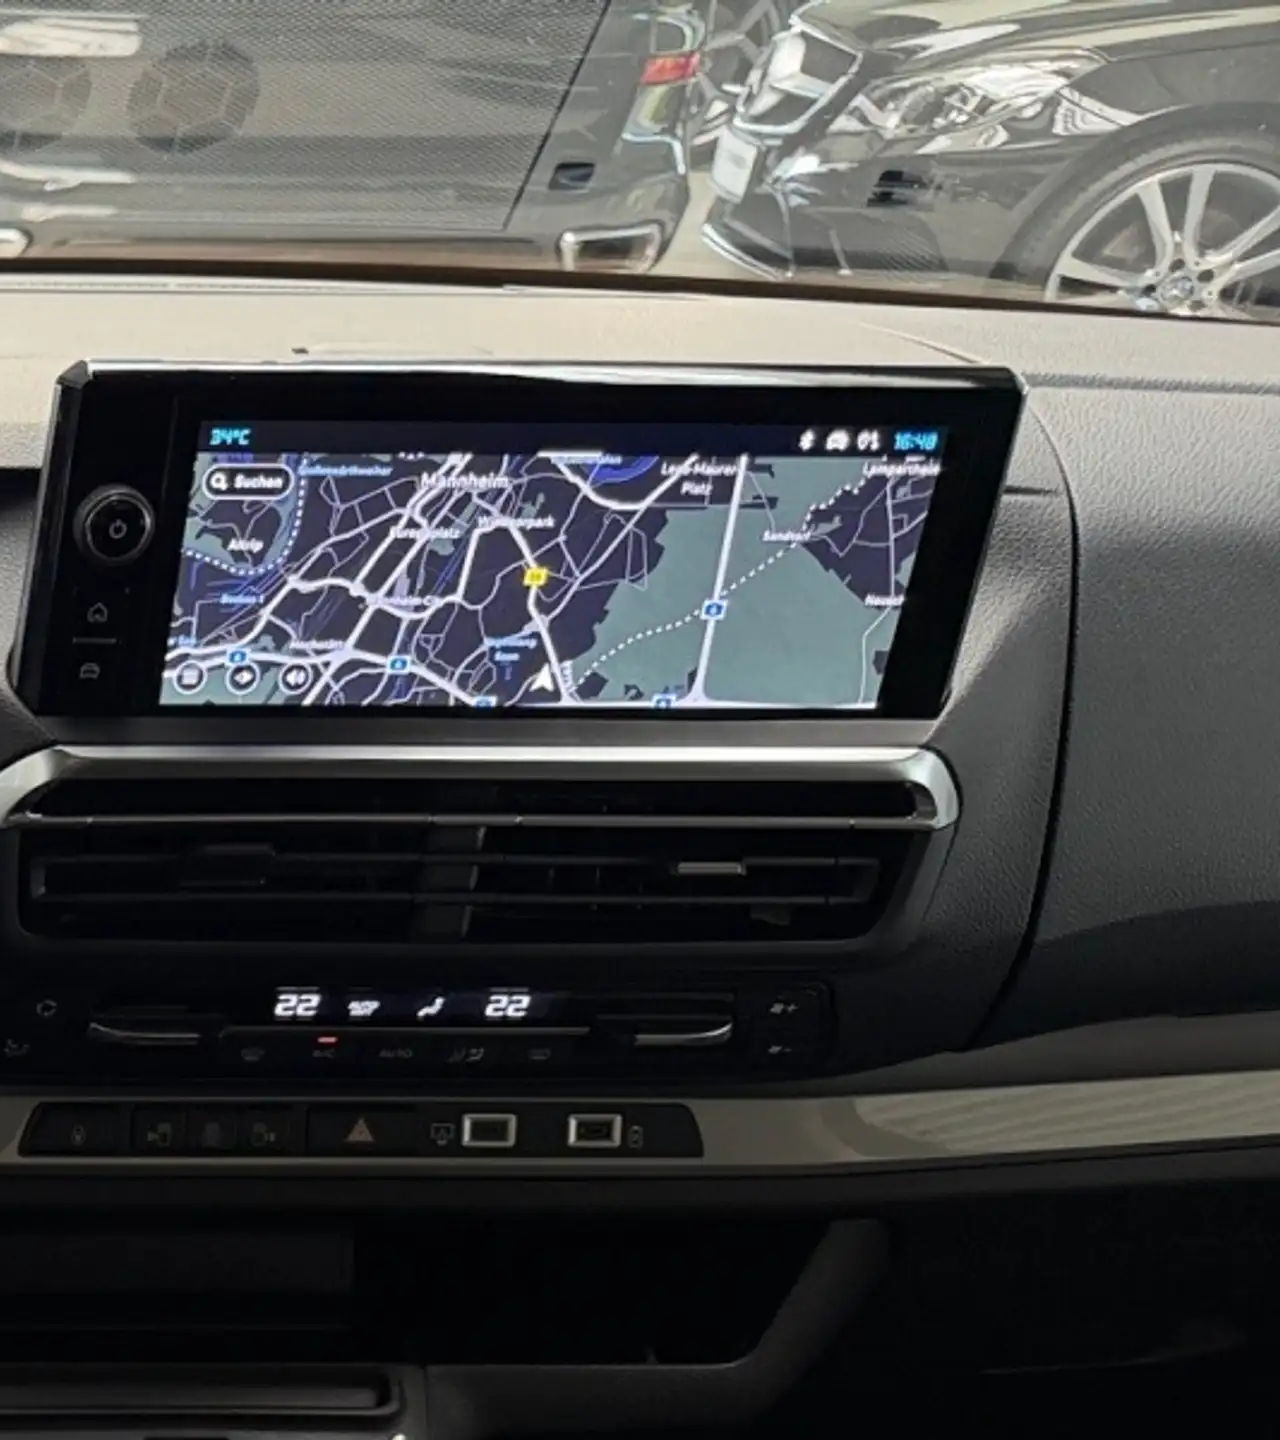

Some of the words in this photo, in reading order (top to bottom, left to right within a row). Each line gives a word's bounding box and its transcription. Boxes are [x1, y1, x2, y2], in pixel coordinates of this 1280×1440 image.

[234, 473, 284, 490] Suchen
[419, 471, 509, 489] Mannheim
[274, 993, 322, 1017] 22
[485, 993, 532, 1017] 22
